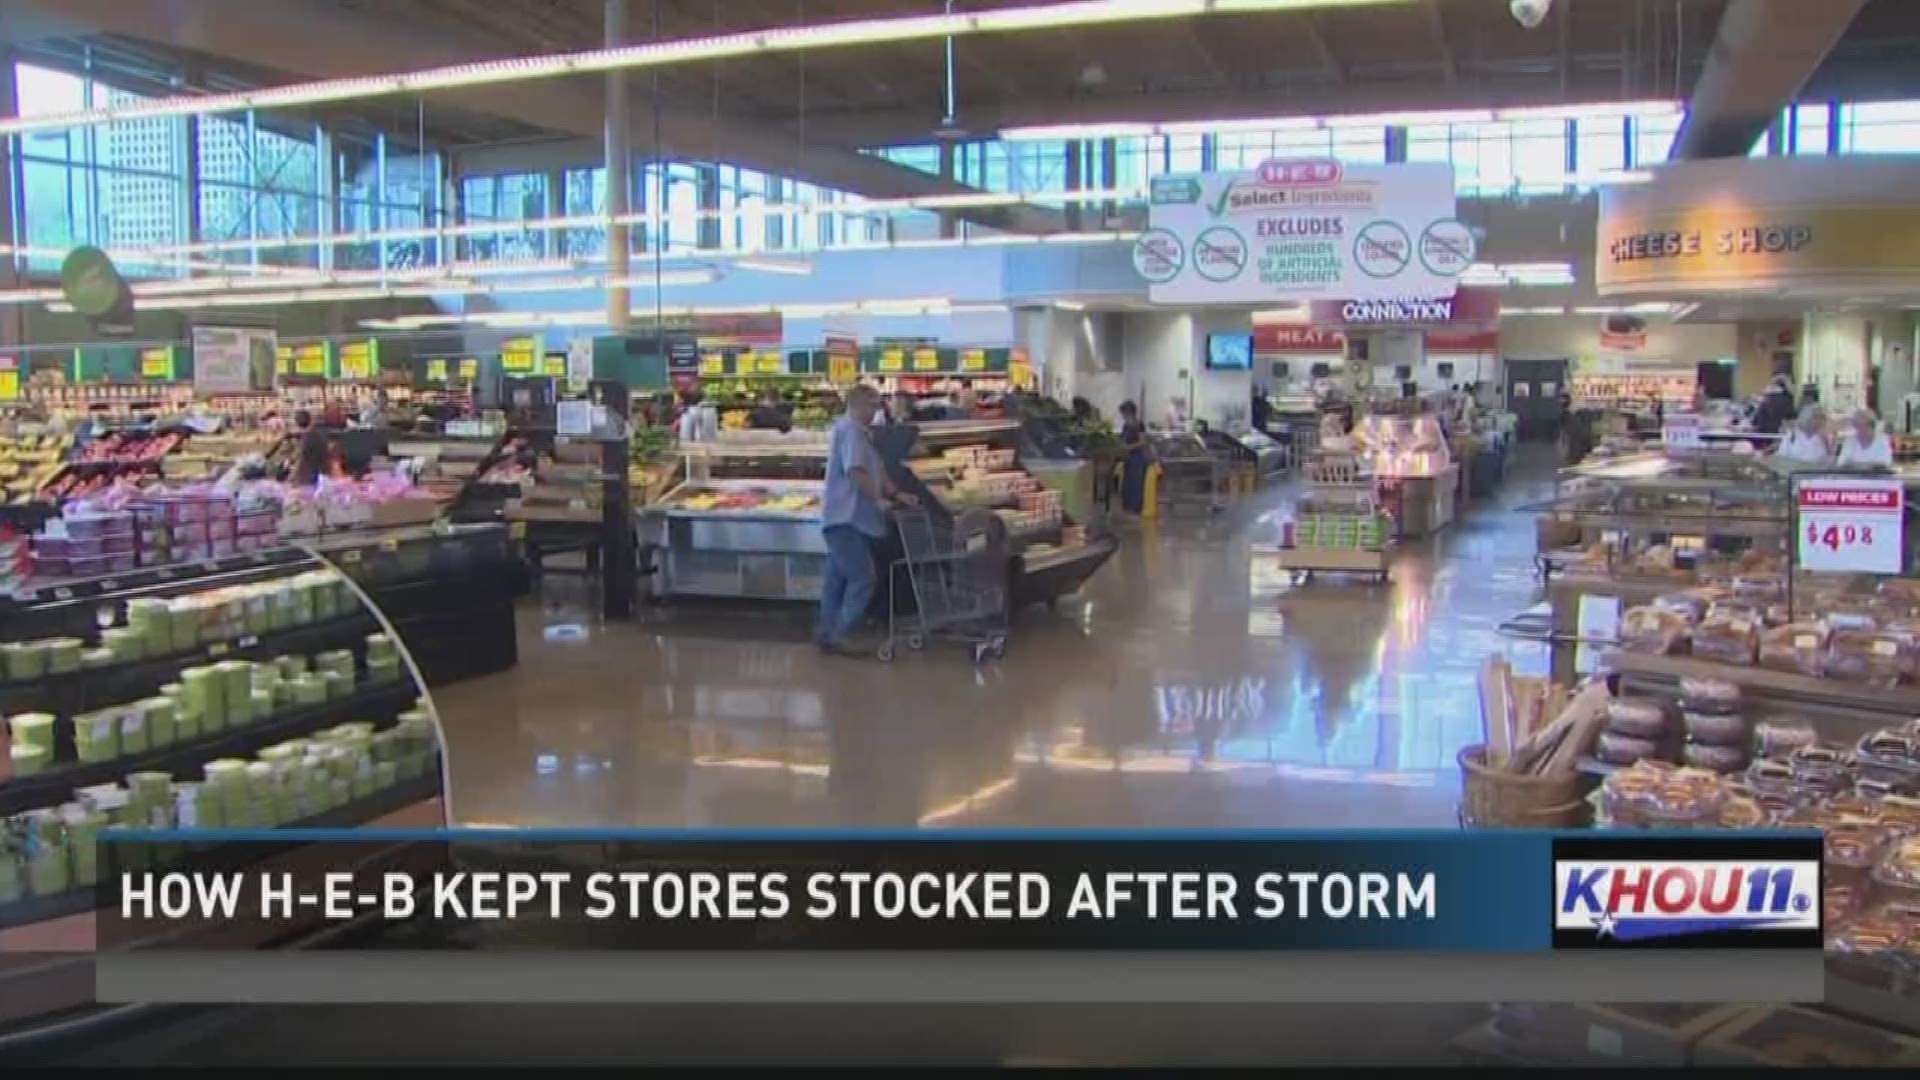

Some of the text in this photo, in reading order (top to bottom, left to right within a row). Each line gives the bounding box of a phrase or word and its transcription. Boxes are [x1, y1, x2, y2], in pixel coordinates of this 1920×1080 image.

[1230, 190, 1286, 207] Select
[1256, 217, 1344, 236] EXCLUDES
[1715, 225, 1812, 256] SHOP
[1343, 302, 1451, 321] CONNECTION
[1277, 330, 1323, 343] MEAT
[1805, 490, 1839, 503] LOW
